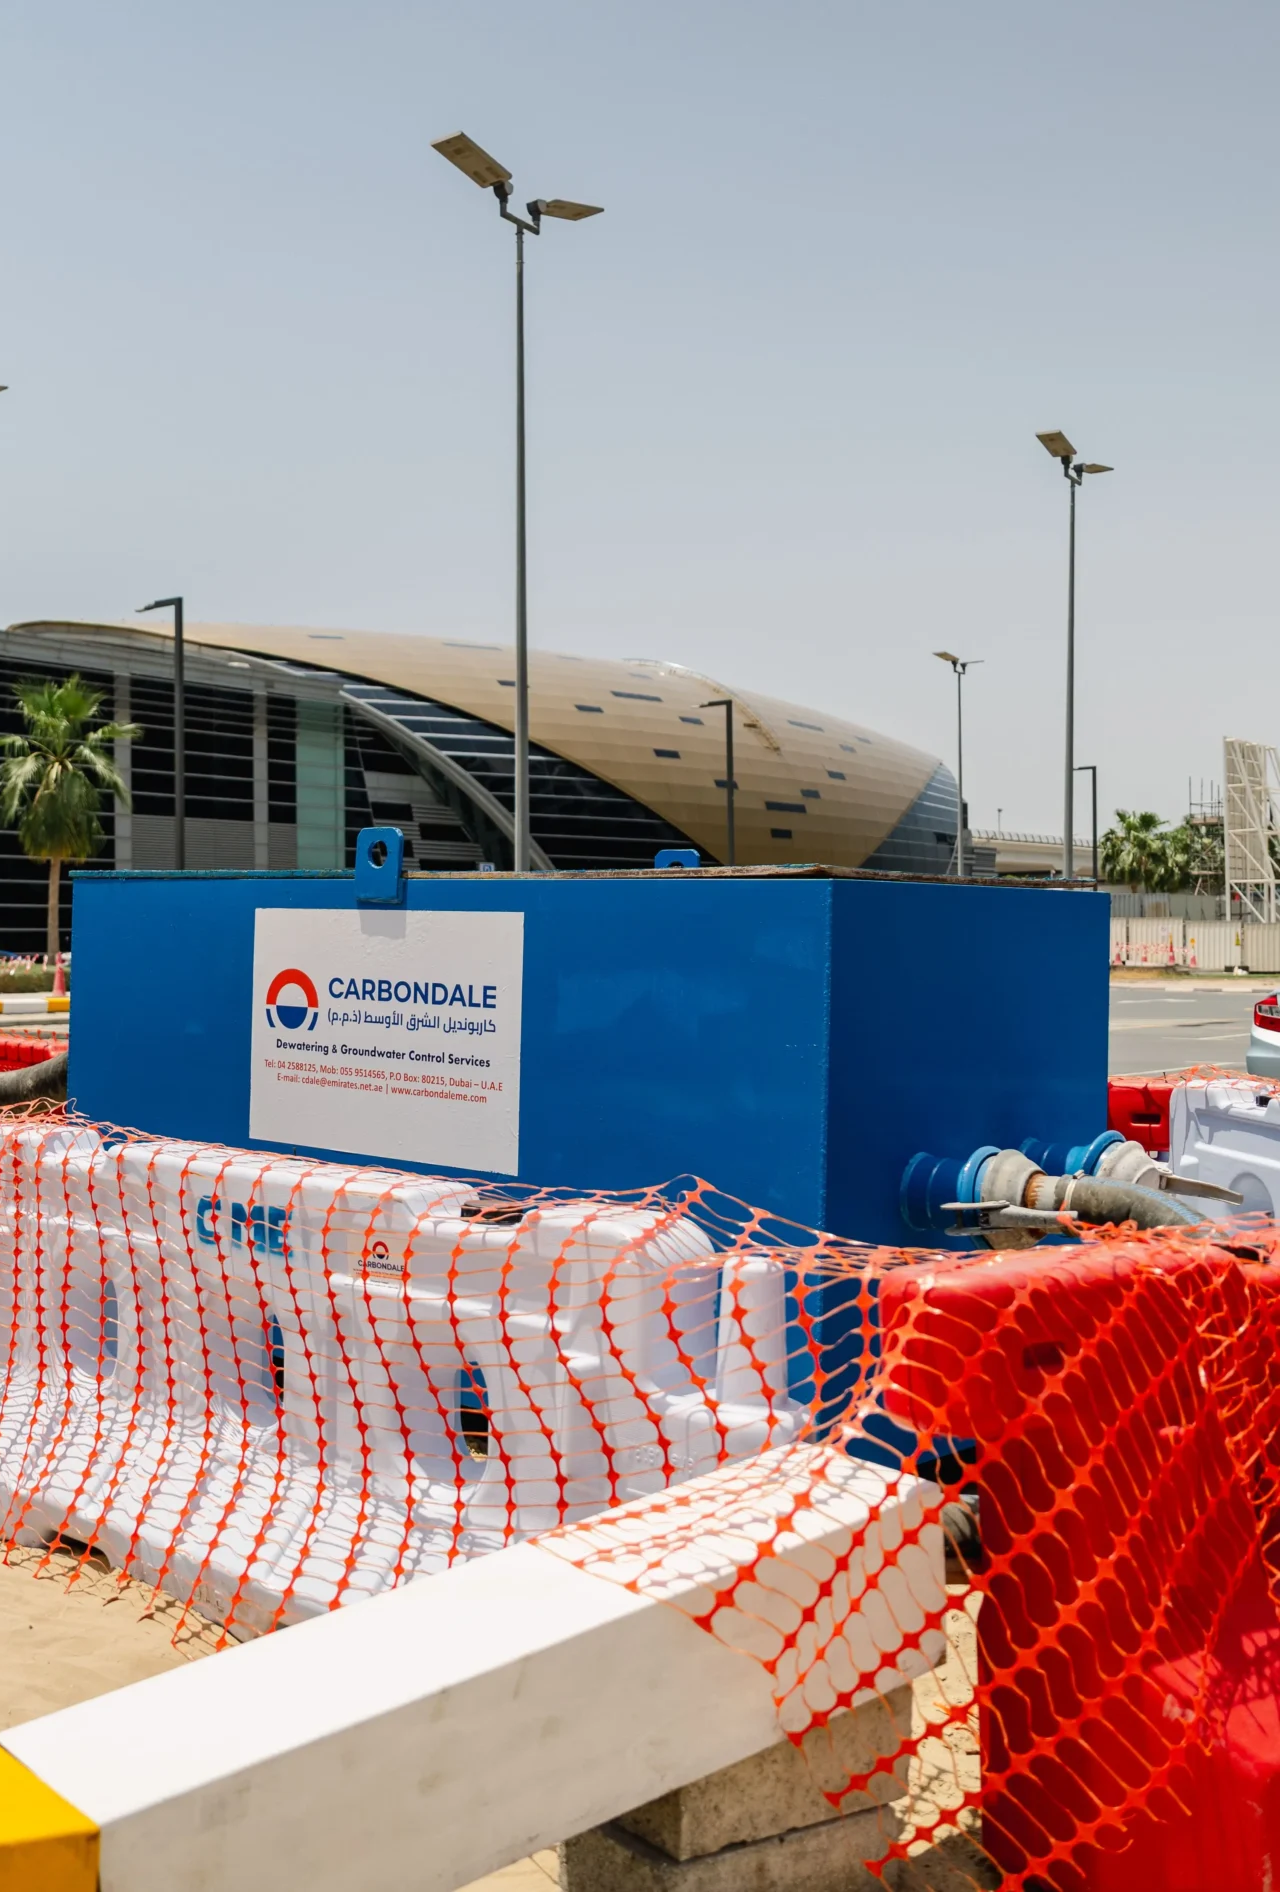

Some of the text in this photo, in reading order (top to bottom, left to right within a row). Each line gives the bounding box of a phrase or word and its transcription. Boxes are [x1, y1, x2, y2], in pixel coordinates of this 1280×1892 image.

[328, 977, 497, 1009] CARBONDALE
[364, 1010, 403, 1028] الأوسط
[406, 1012, 440, 1031] الشرق
[443, 1017, 496, 1036] كاربونديل
[276, 1038, 491, 1068] Dewatering & Groundwater Control Services
[264, 1059, 276, 1068] Tel:
[277, 1060, 286, 1069] 04
[287, 1061, 318, 1074] 2588125,
[319, 1064, 339, 1075] Mob:
[339, 1066, 353, 1076] 055
[354, 1068, 388, 1081] 9514565,
[389, 1071, 402, 1081] P.O
[403, 1072, 420, 1083] Box:
[421, 1075, 448, 1087] 80215,
[449, 1077, 472, 1088] Dubai
[481, 1080, 503, 1091] U.A.E
[277, 1072, 300, 1083] E-mail:
[301, 1075, 383, 1092] cdale@emirates.net.ae
[390, 1085, 487, 1103] www.carbondaleme.com
